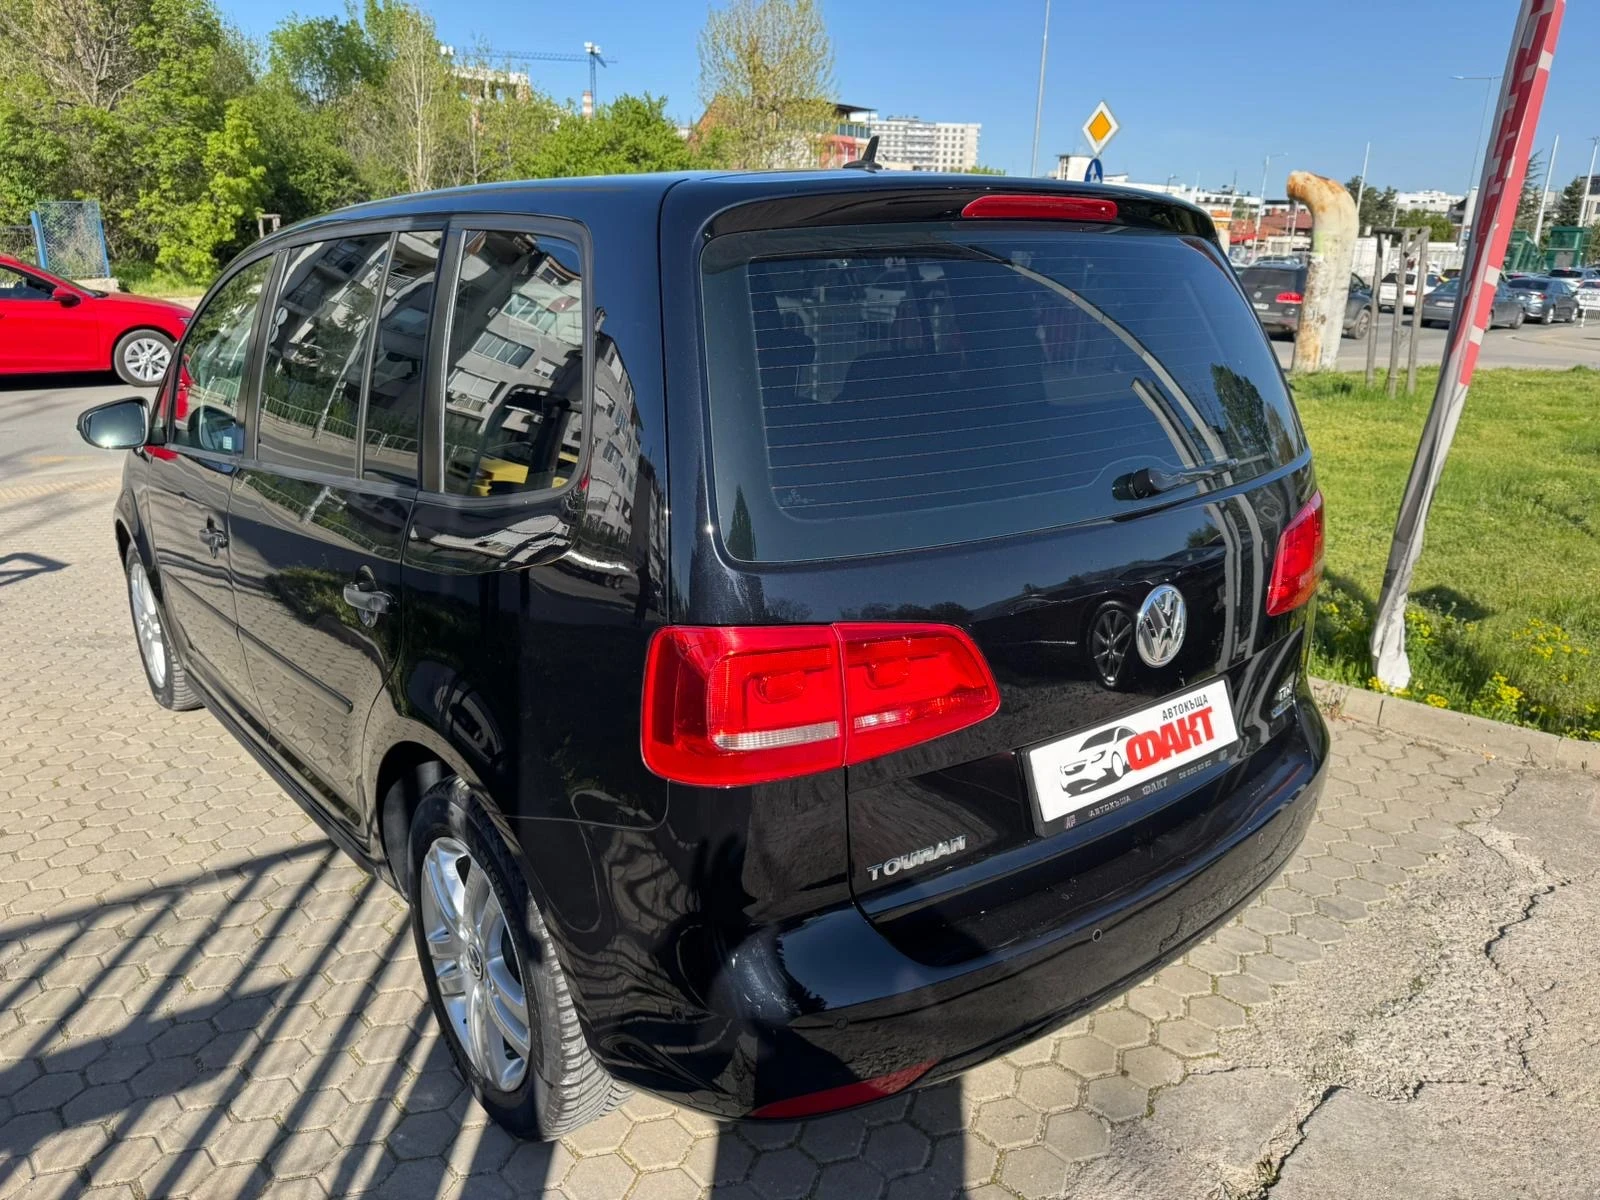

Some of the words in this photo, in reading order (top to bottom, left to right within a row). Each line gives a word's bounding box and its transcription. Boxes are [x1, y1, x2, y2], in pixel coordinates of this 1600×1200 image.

[1162, 694, 1208, 721] АВТОКЪЩА
[1126, 706, 1214, 770] ФАКТ
[866, 835, 966, 881] TOURAN
